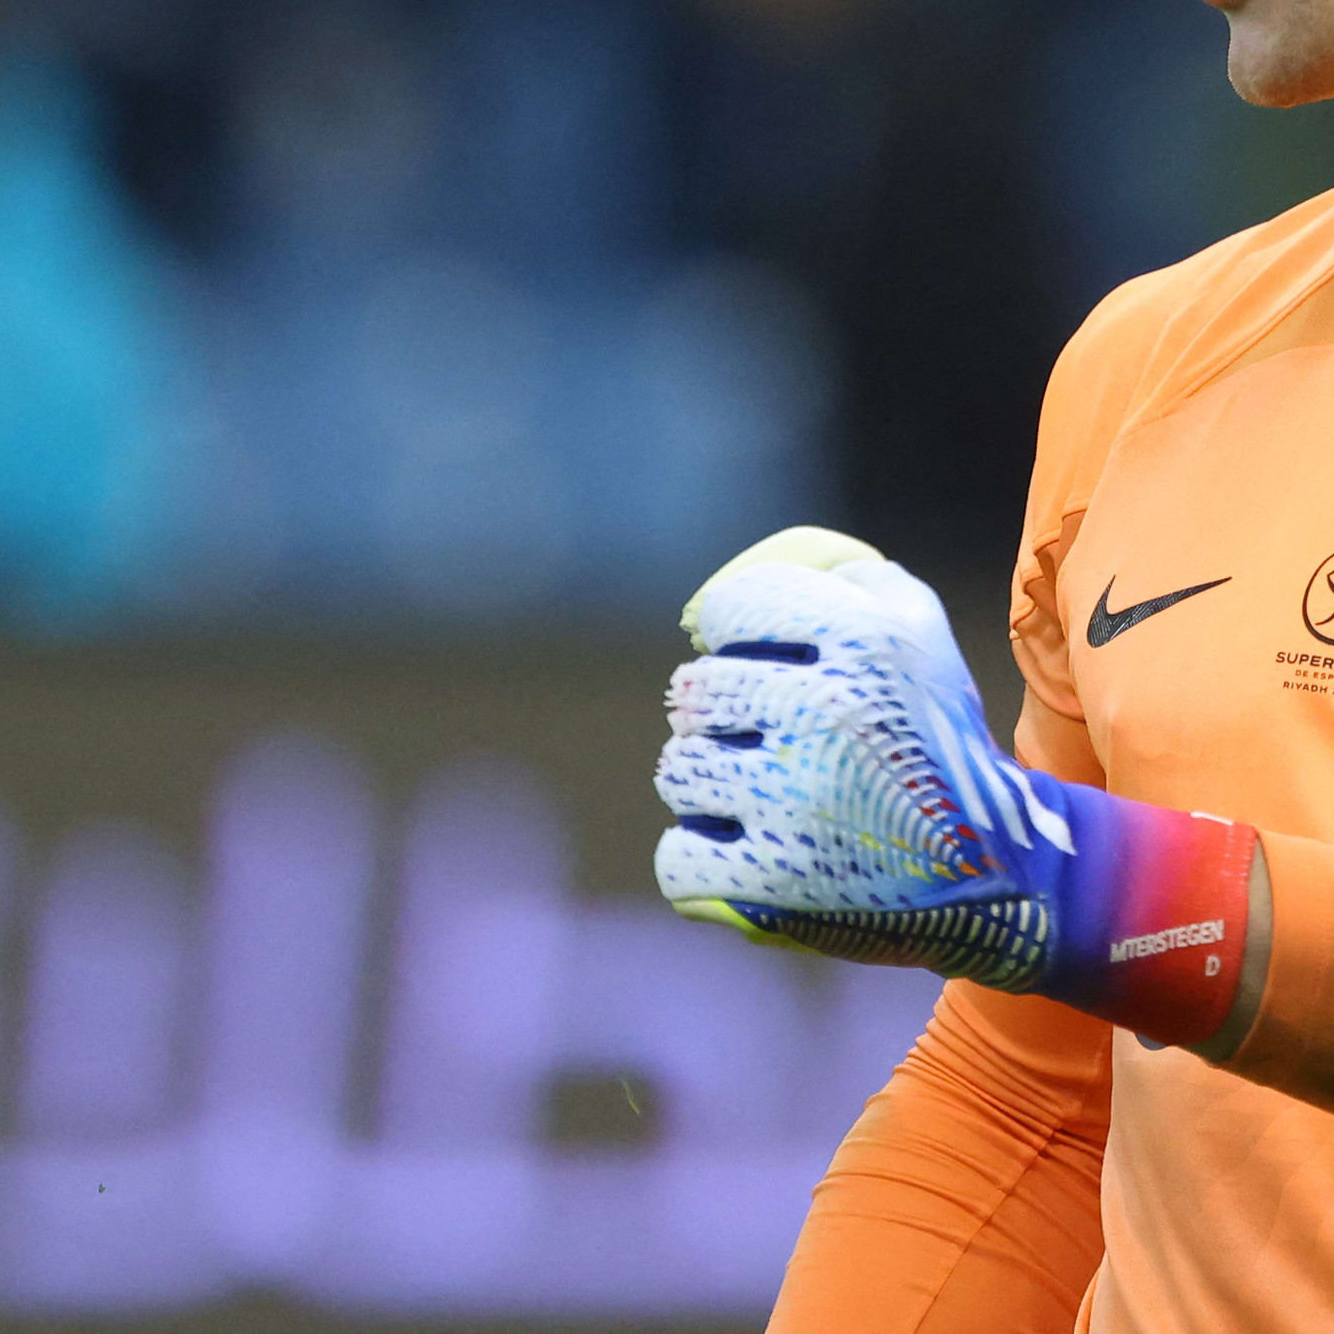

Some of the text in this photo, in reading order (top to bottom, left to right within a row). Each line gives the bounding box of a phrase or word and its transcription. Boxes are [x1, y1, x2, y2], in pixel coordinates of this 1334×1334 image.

[1295, 669, 1308, 678] DE
[1282, 681, 1328, 694] RIYADH
[1110, 919, 1225, 963] MTERSTEGEN
[1205, 953, 1221, 977] D
